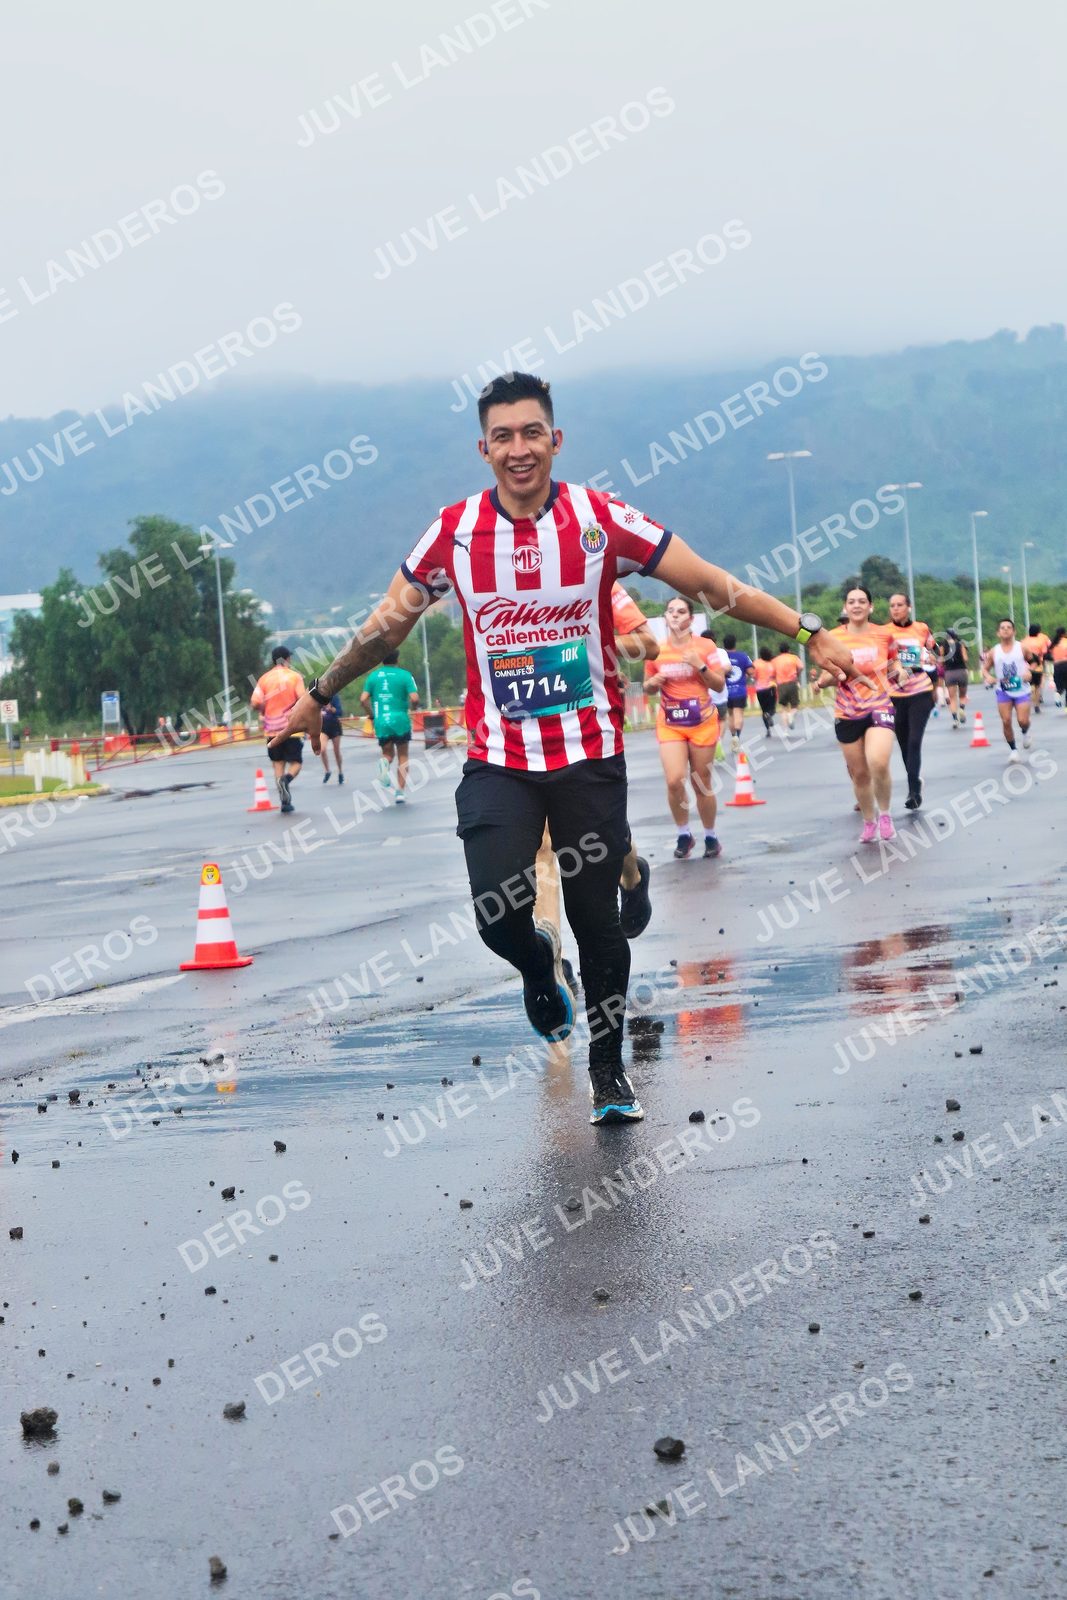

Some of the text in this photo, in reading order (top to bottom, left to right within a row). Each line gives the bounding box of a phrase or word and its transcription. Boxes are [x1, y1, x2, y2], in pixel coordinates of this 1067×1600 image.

[514, 548, 541, 571] MG
[472, 596, 592, 635] Caliente
[486, 623, 592, 647] caliente.mx
[493, 655, 535, 670] CARRERA
[560, 646, 579, 663] 10K
[507, 674, 568, 701] 1714
[672, 709, 690, 719] 687
